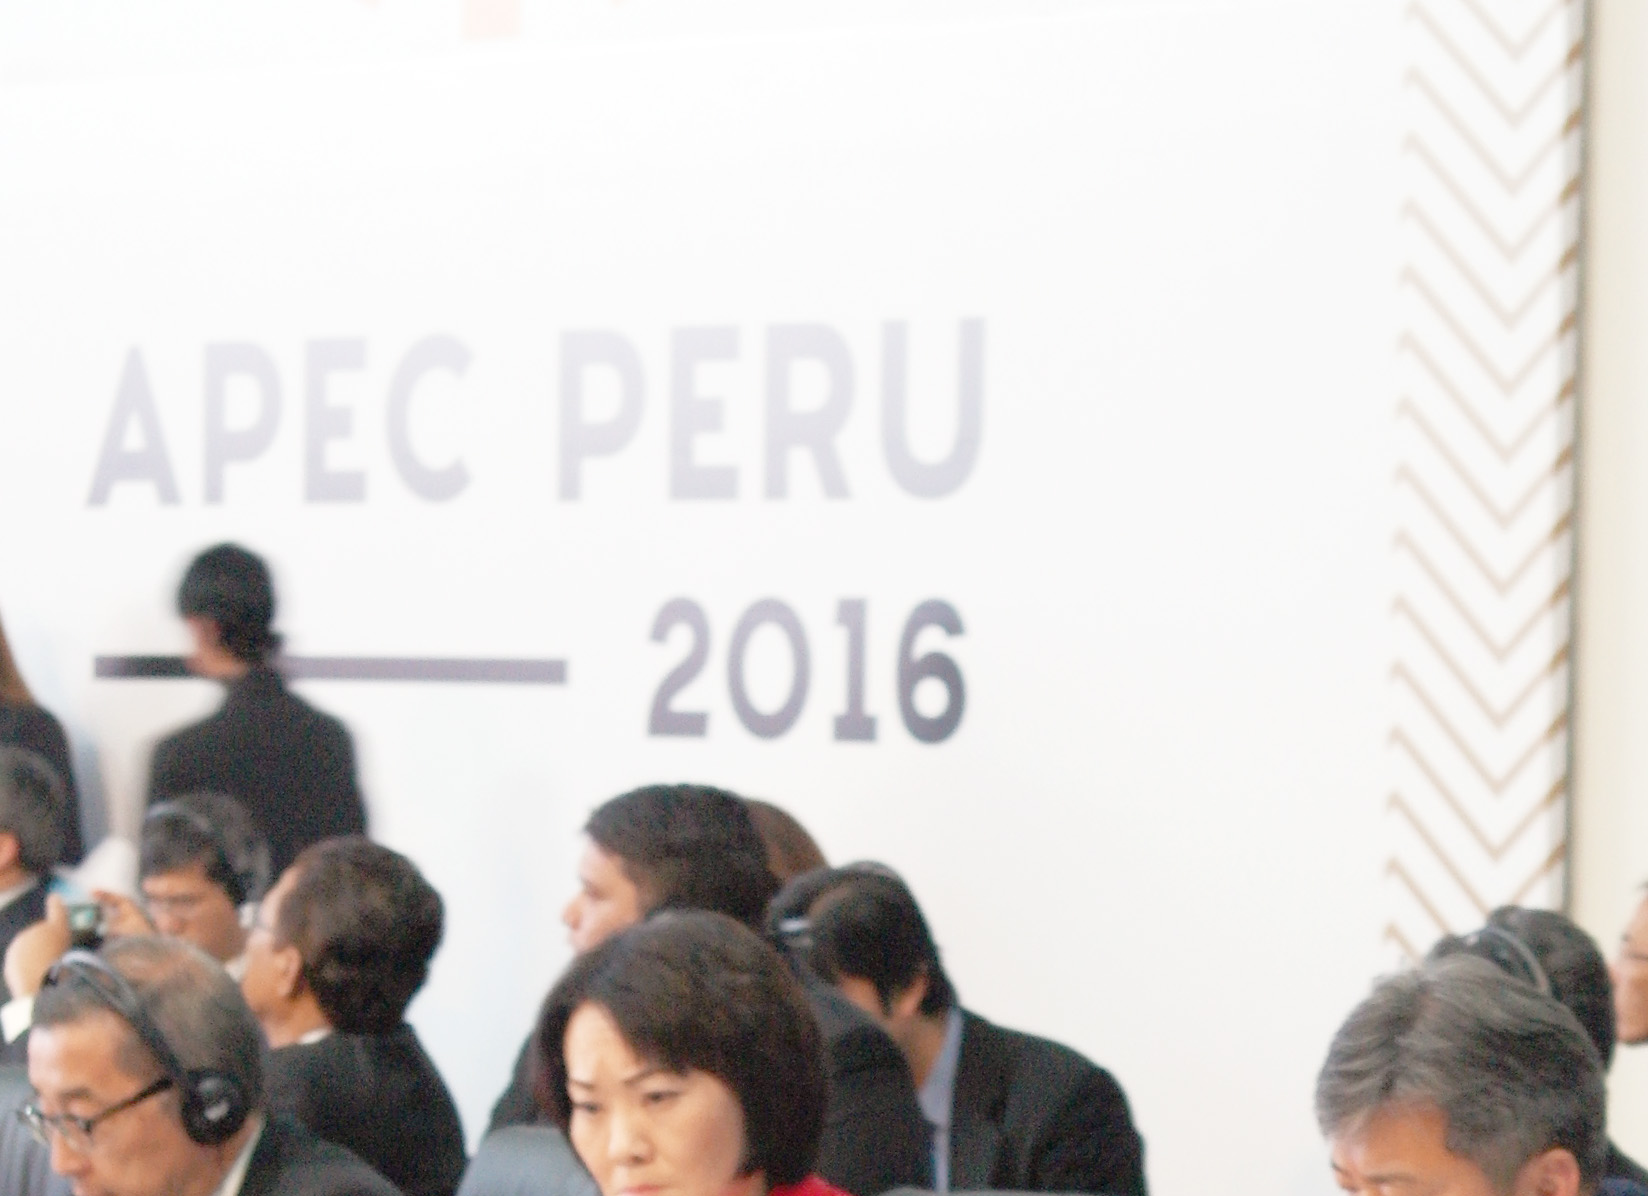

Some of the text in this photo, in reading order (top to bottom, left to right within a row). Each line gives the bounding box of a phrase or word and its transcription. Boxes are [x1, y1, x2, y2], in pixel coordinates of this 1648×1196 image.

[85, 317, 985, 508] APEC PERU
[647, 597, 970, 746] 2016
